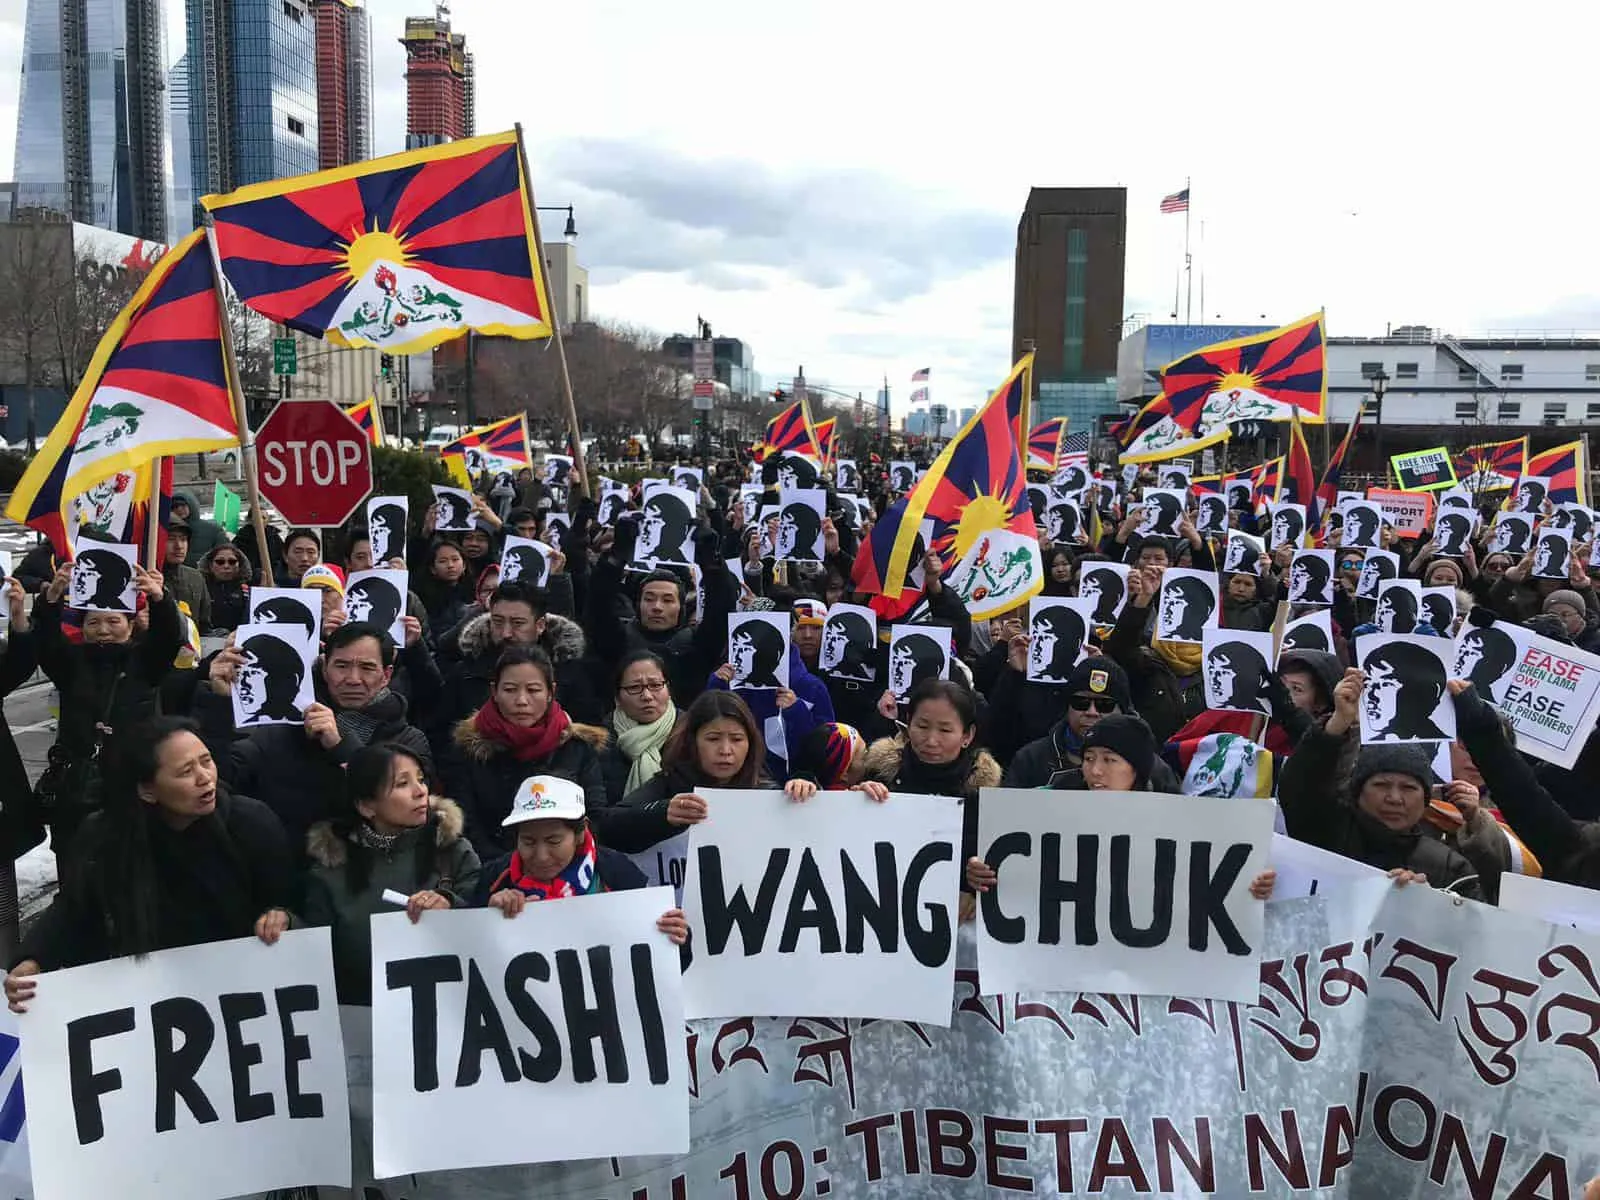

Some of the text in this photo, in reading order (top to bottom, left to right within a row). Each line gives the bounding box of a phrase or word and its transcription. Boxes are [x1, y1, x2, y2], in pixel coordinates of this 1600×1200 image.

[1152, 328, 1176, 340] EAT
[1184, 328, 1233, 341] DRINK
[264, 440, 362, 486] STOP
[1398, 452, 1443, 469] FREE TIBET
[1513, 673, 1541, 689] OW!
[1547, 673, 1577, 693] LAMA
[1514, 705, 1574, 735] PRISONERS
[697, 841, 953, 967] WANG
[981, 832, 1252, 956] CHUK
[386, 943, 669, 1092] TASHI
[67, 984, 324, 1145] FREE
[719, 1071, 1573, 1200] 10: TIBETAN NAIONA
